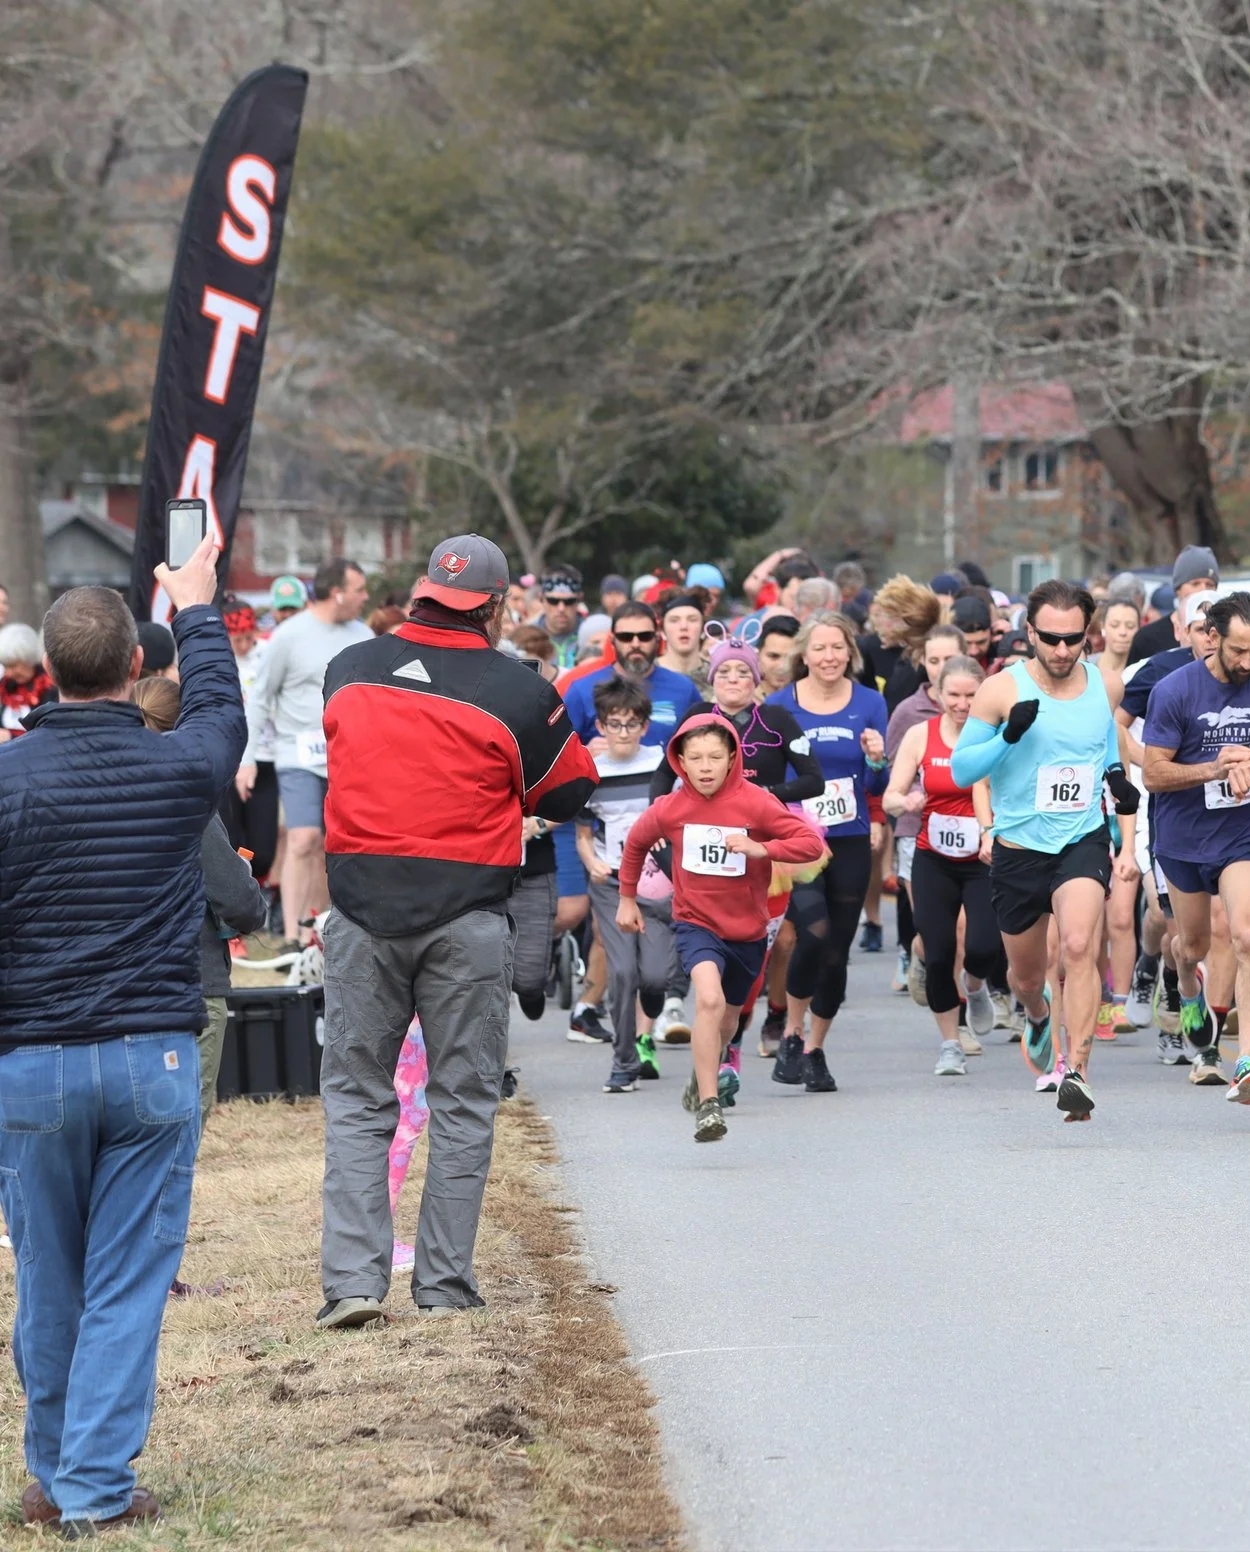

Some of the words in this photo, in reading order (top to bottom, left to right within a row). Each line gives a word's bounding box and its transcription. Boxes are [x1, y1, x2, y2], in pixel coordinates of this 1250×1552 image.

[1050, 783, 1081, 802] 162
[815, 797, 846, 818] 230
[939, 831, 965, 848] 105
[699, 844, 727, 865] 157
